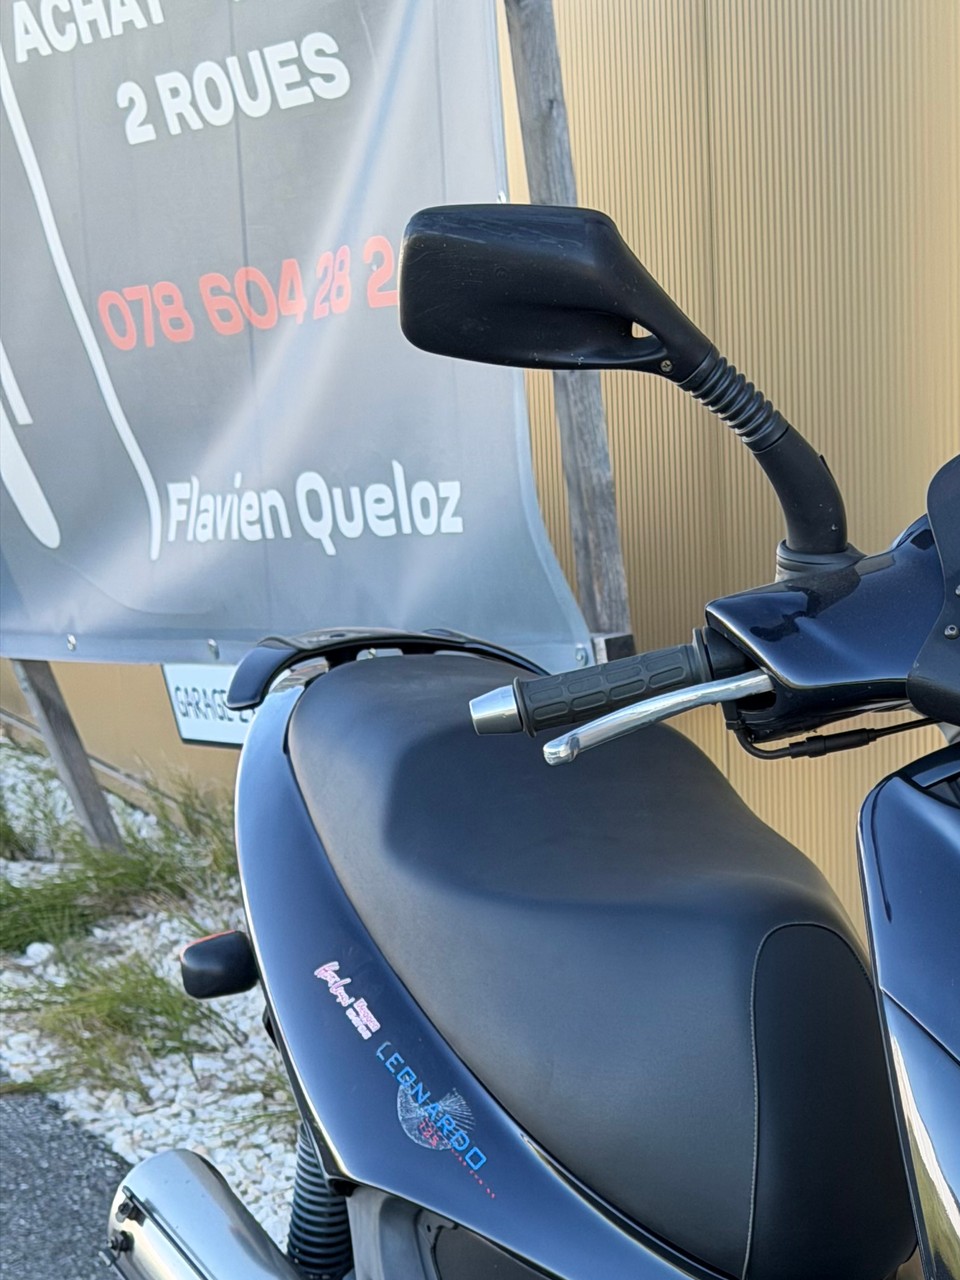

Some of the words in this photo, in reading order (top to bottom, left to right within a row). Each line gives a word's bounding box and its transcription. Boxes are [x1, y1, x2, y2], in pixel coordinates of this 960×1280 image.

[116, 81, 156, 145] 2
[155, 31, 350, 136] ROUES
[98, 281, 194, 350] 078
[199, 259, 307, 335] 604
[313, 245, 350, 320] 28
[167, 472, 292, 543] Flavien
[295, 459, 463, 556] Queloz
[376, 1041, 487, 1171] LEONARDO
